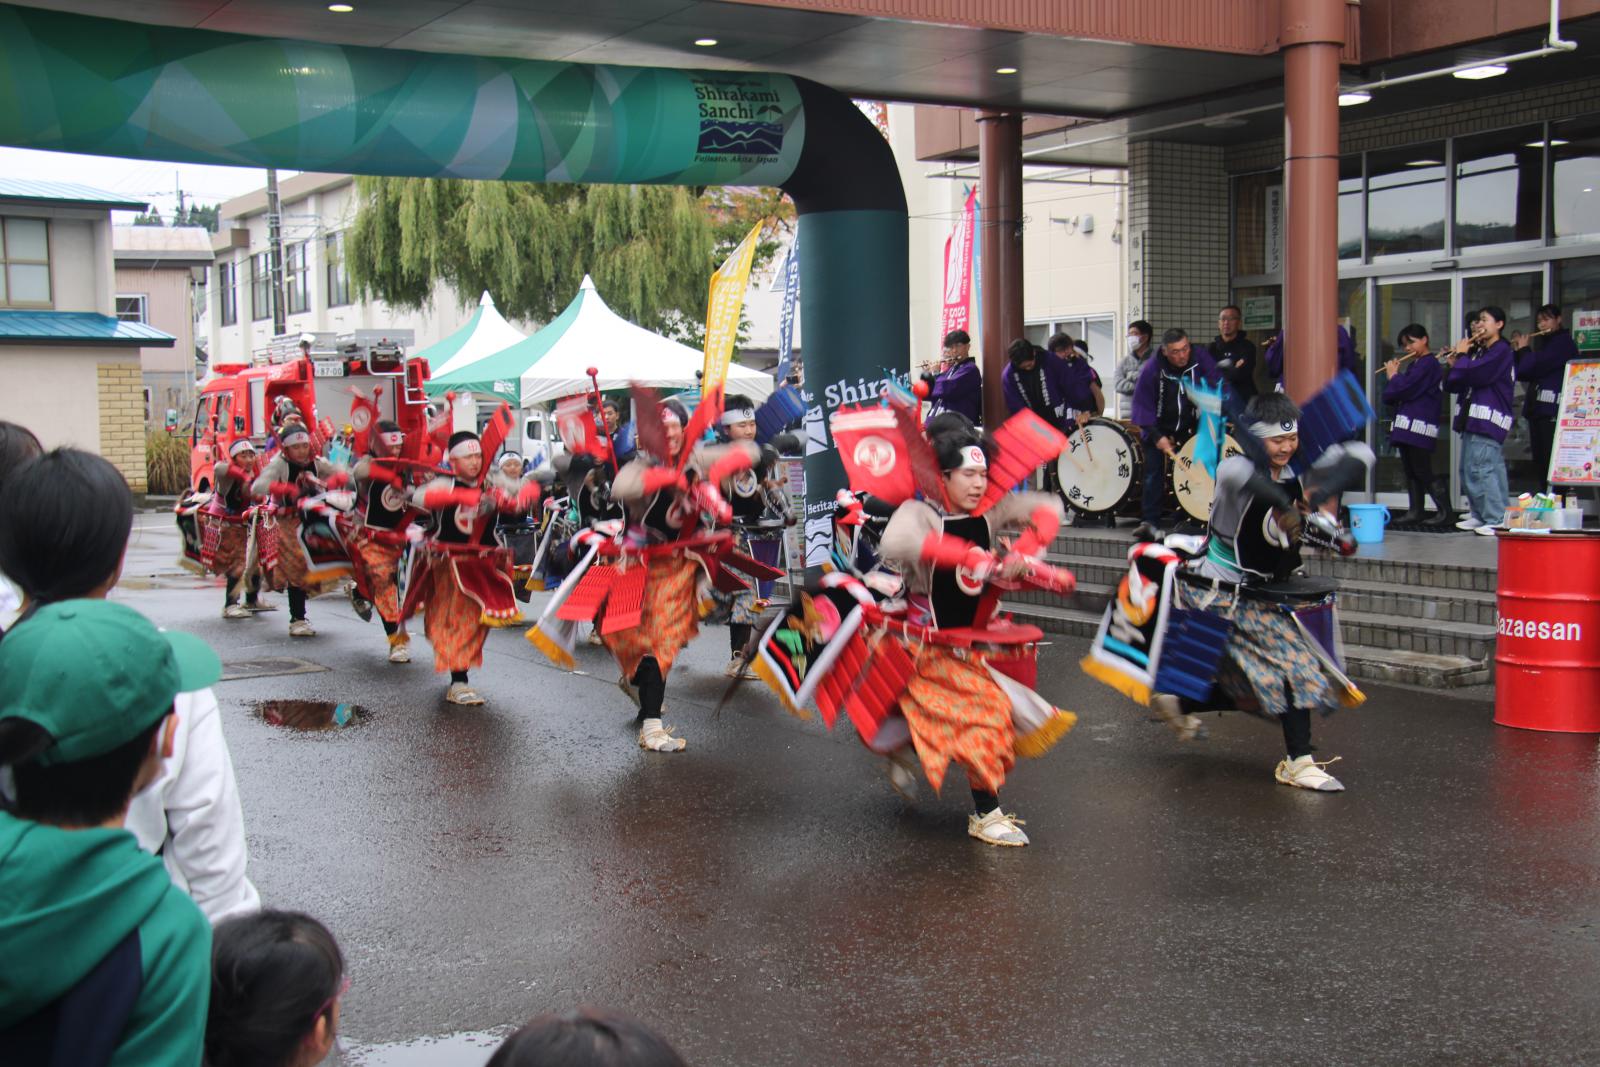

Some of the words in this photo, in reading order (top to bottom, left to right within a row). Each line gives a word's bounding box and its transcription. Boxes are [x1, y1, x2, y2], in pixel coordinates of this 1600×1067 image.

[695, 86, 780, 103] Shirakami
[698, 102, 754, 119] Sanchi
[807, 500, 839, 515] Heritag
